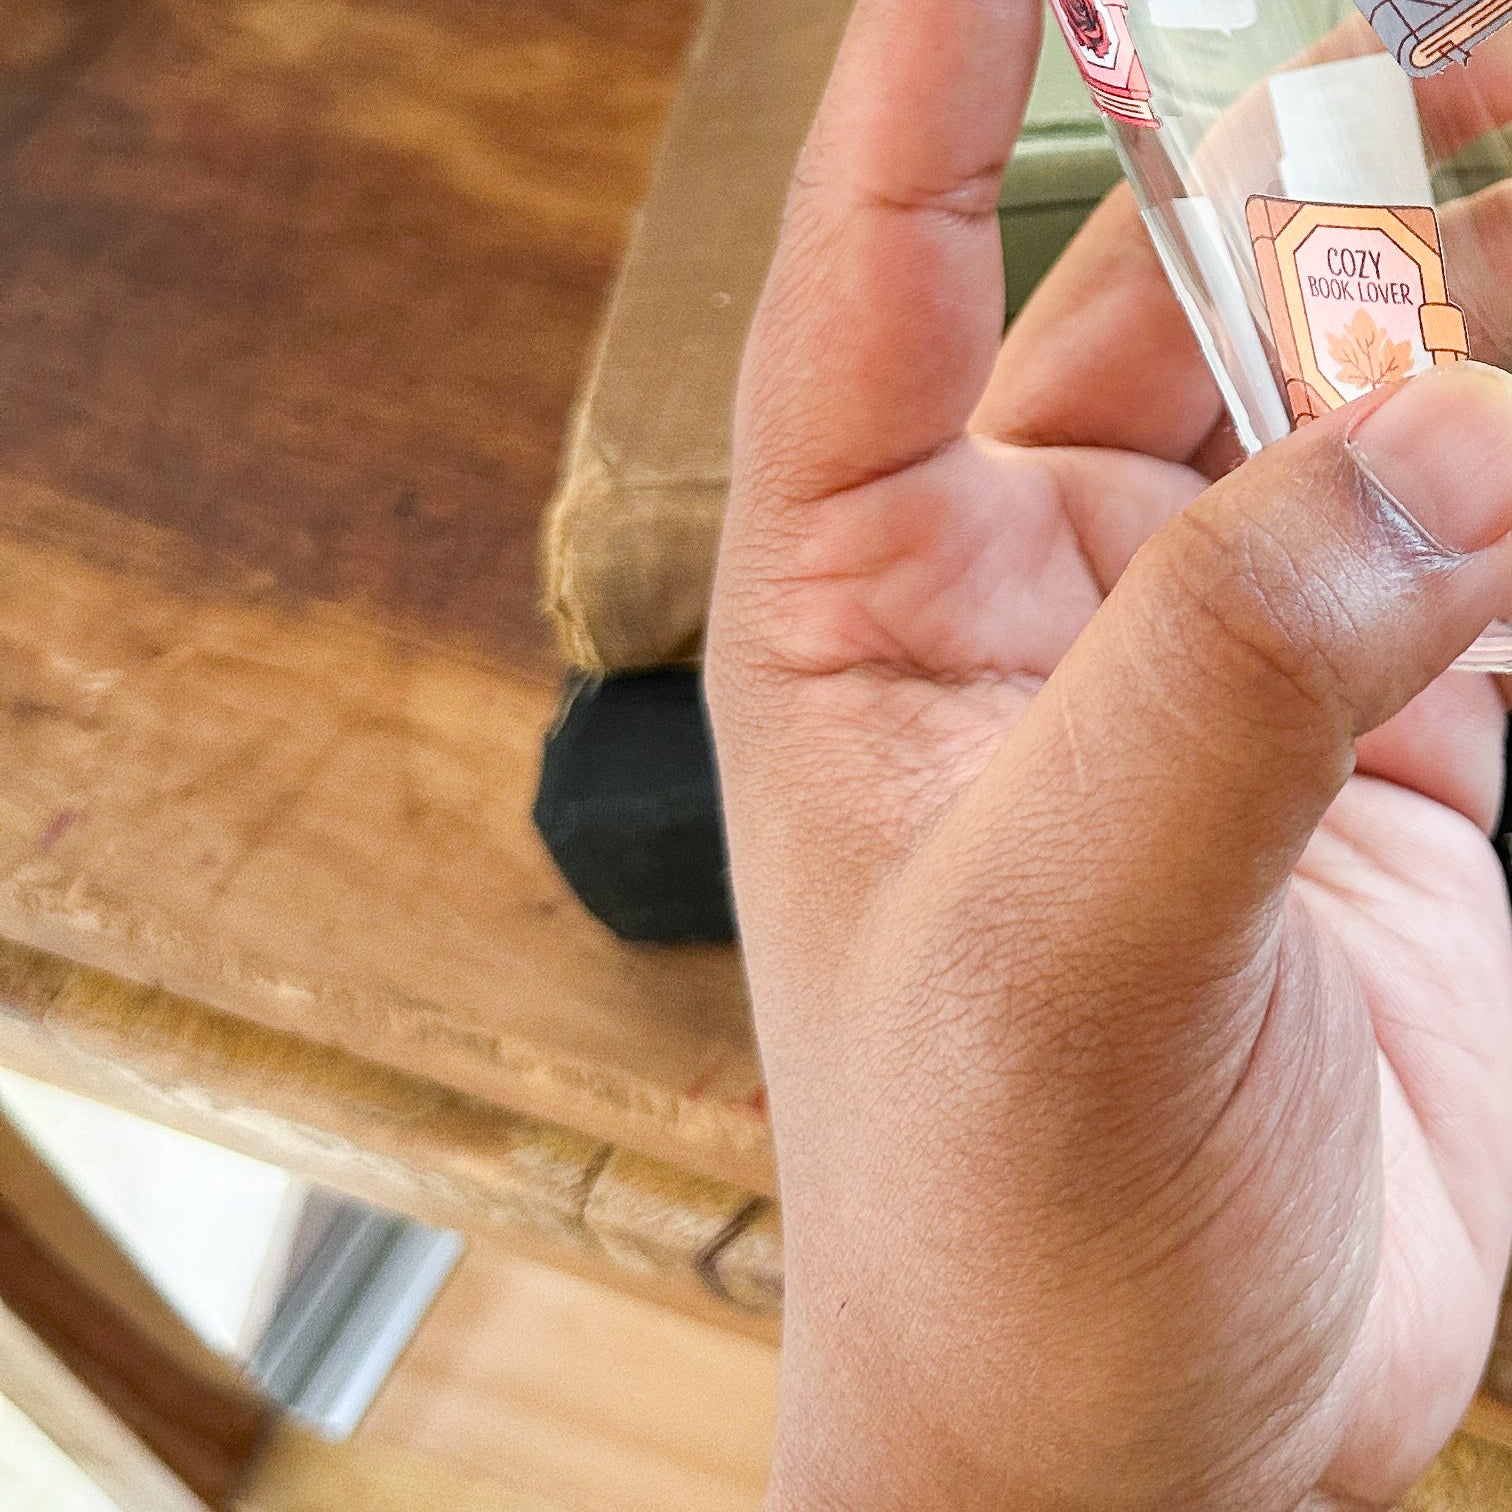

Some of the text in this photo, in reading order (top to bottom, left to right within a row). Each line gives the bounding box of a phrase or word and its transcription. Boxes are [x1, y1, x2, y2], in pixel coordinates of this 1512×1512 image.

[1326, 246, 1381, 280] COZY
[1307, 275, 1414, 306] BOOK LOVER
